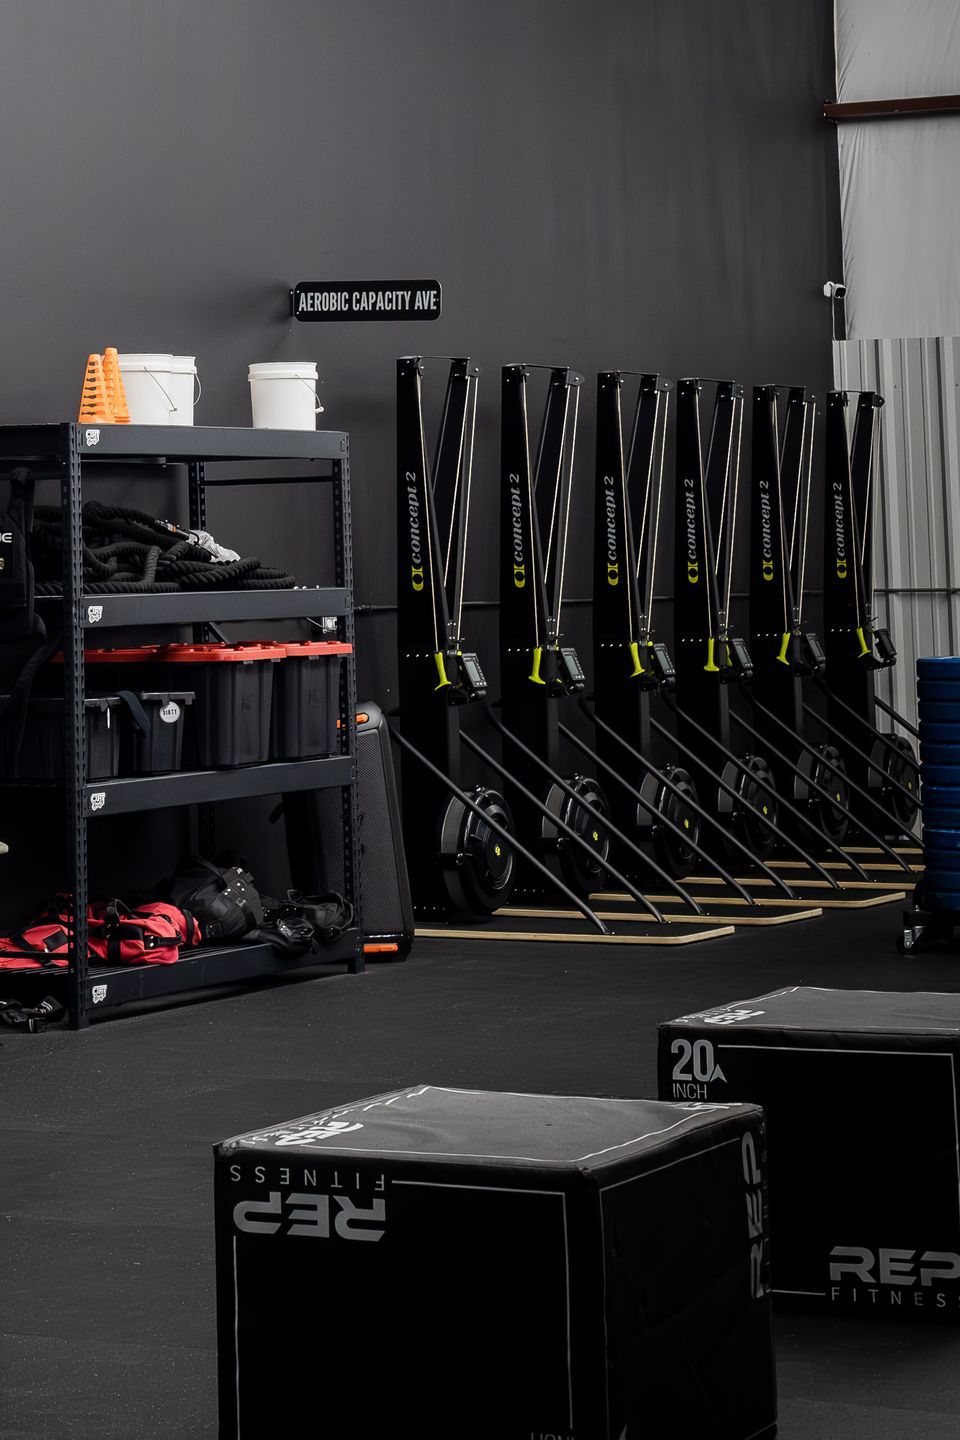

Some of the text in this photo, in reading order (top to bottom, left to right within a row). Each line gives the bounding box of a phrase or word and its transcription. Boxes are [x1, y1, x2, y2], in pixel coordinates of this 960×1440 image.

[298, 290, 437, 311] AEROBIC CAPACITY AVE
[405, 471, 422, 564] concept 2
[509, 473, 524, 562] concept 2
[603, 475, 617, 561] concept 2
[683, 478, 697, 560] concept 2
[759, 480, 772, 559] concept 2
[832, 482, 845, 557] concept 2
[671, 1039, 714, 1082] 20
[672, 1083, 708, 1100] INCH
[229, 1164, 386, 1192] FITNESS
[233, 1192, 387, 1242] REP
[831, 1287, 960, 1309] FITNES
